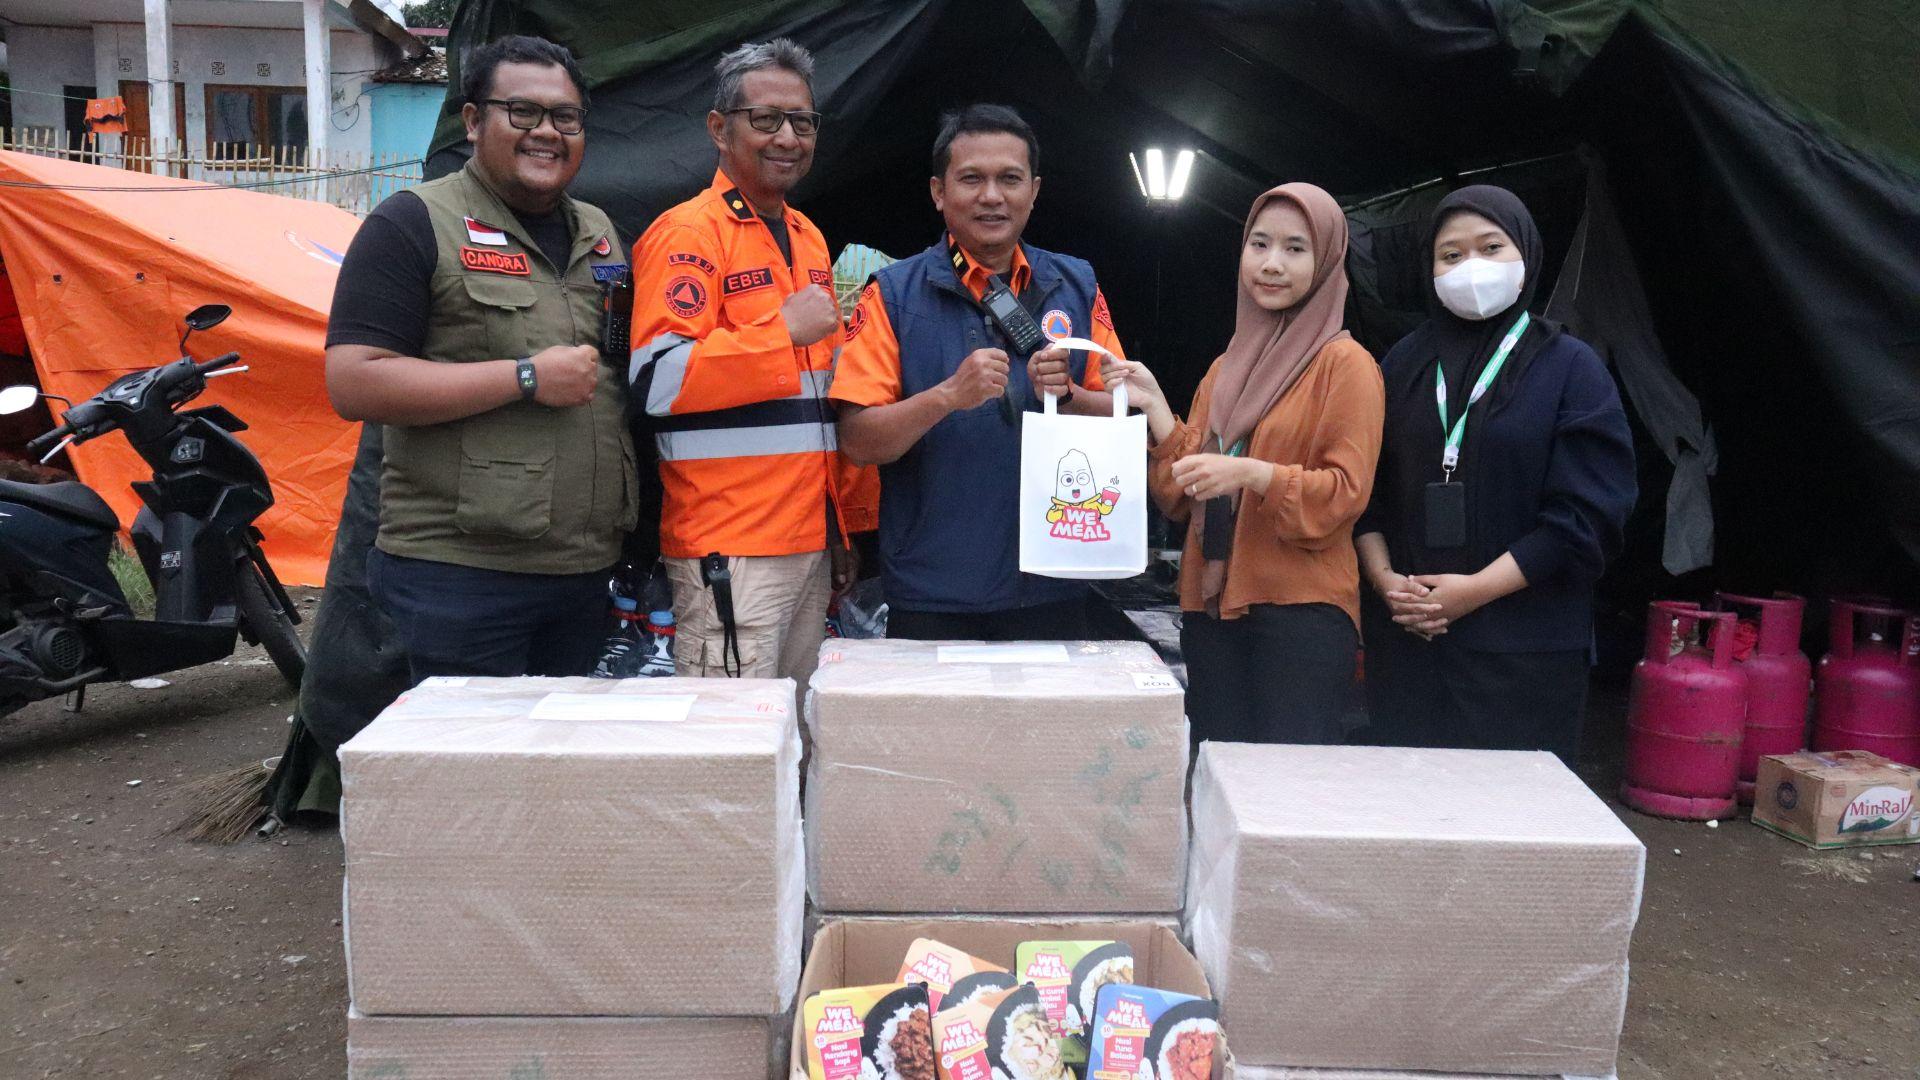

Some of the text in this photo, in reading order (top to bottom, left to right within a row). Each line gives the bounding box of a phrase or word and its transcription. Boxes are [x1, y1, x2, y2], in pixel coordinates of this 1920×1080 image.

[466, 252, 524, 270] CANDRA
[727, 270, 766, 291] EBET
[810, 271, 829, 284] BP
[1065, 508, 1097, 525] WE
[1053, 522, 1107, 539] MEAL
[927, 953, 950, 974] WE
[1036, 953, 1062, 967] WE
[911, 961, 952, 987] MEAL
[1027, 965, 1071, 978] MEAL
[825, 1007, 852, 1020] WE
[1119, 1000, 1143, 1017] WE
[817, 1019, 863, 1032] MEAL
[1106, 1010, 1150, 1029] MEAL
[946, 1022, 972, 1038] WE
[830, 1042, 848, 1052] Nasi
[942, 1031, 985, 1052] MEAL
[1115, 1037, 1132, 1045] Nasi
[824, 1049, 858, 1060] Rendang
